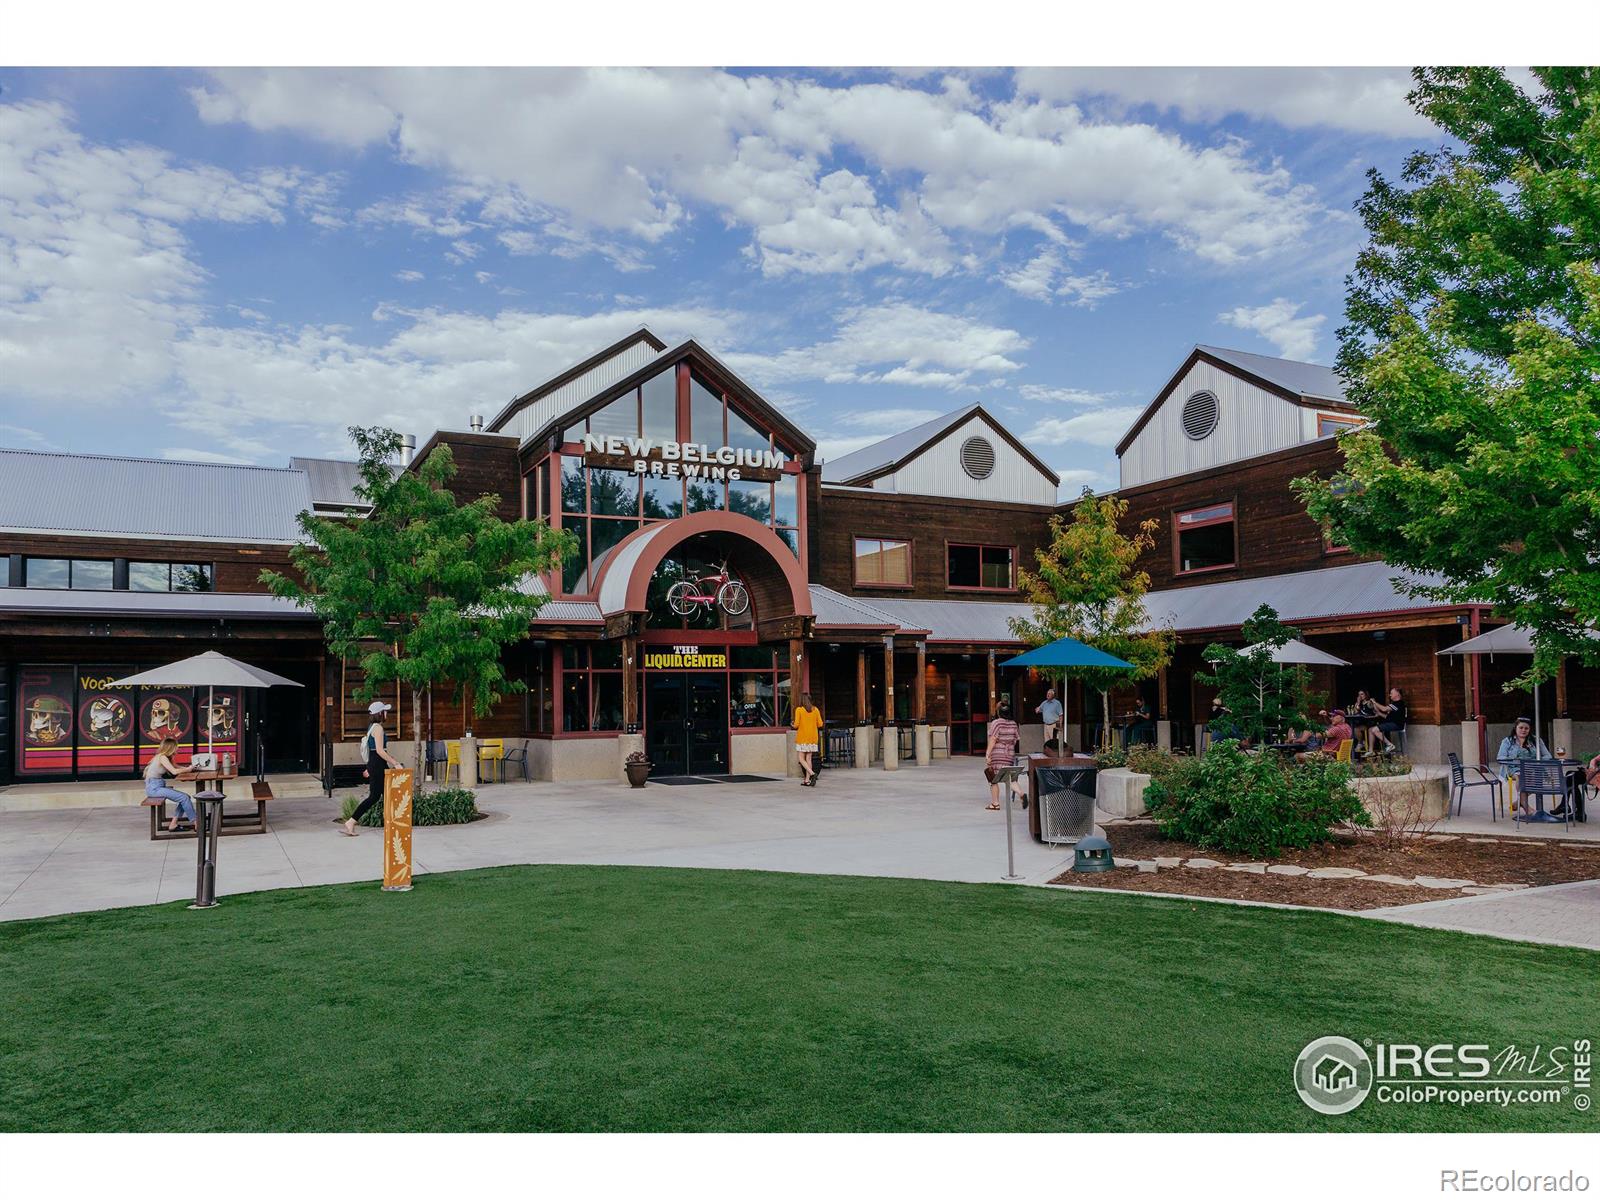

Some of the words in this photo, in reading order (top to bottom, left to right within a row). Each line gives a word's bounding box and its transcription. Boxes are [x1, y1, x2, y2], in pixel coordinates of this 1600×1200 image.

[585, 433, 653, 458] NEW
[661, 440, 785, 470] BELGIUM
[633, 459, 741, 481] BREWING
[673, 645, 699, 655] THE
[645, 654, 683, 669] LIQUID
[683, 654, 726, 668] CENTER
